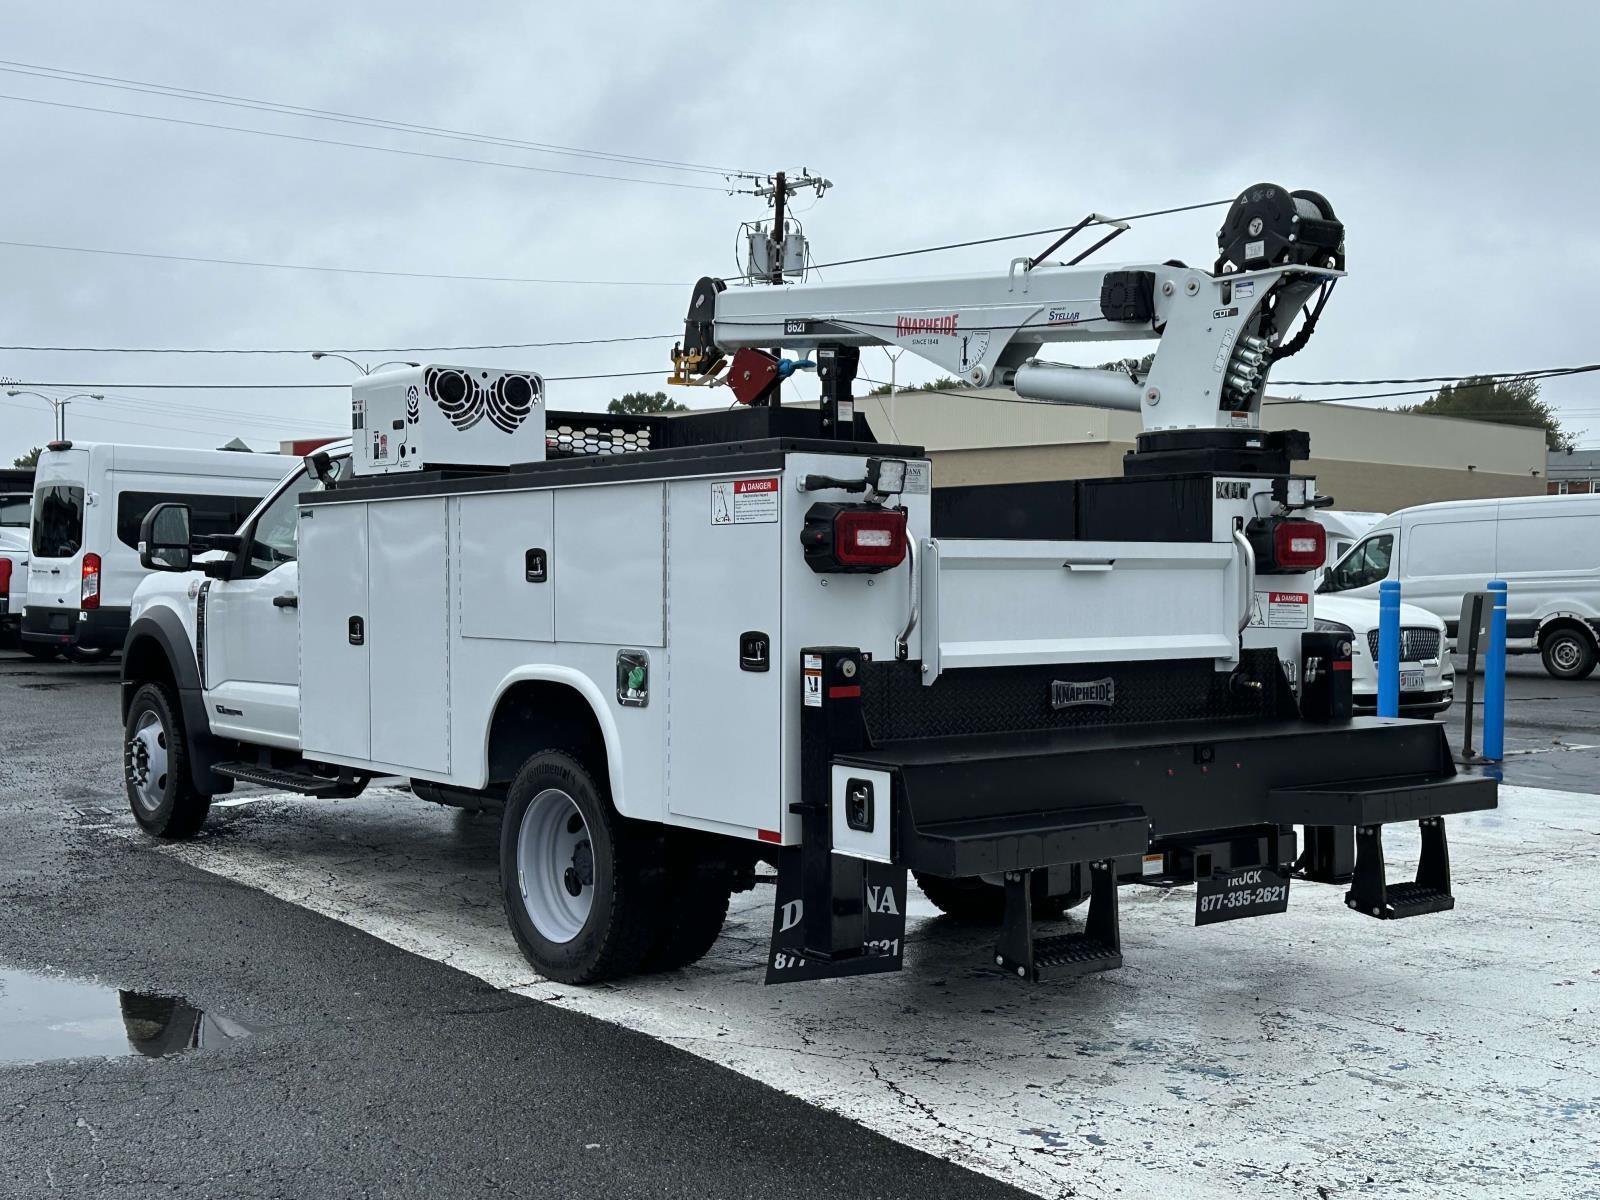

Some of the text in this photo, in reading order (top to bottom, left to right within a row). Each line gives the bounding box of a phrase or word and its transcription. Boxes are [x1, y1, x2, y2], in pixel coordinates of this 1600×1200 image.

[1049, 311, 1080, 320] STELLAR
[787, 320, 805, 333] 8621
[896, 314, 959, 338] KNAPHEIDE
[747, 481, 772, 491] DANGER
[1216, 481, 1251, 500] KMT
[1281, 594, 1303, 602] DANGER
[1055, 682, 1112, 704] KNAPHEIDE
[1227, 870, 1262, 887] TRUCK
[1201, 885, 1286, 912] 877-335-2621
